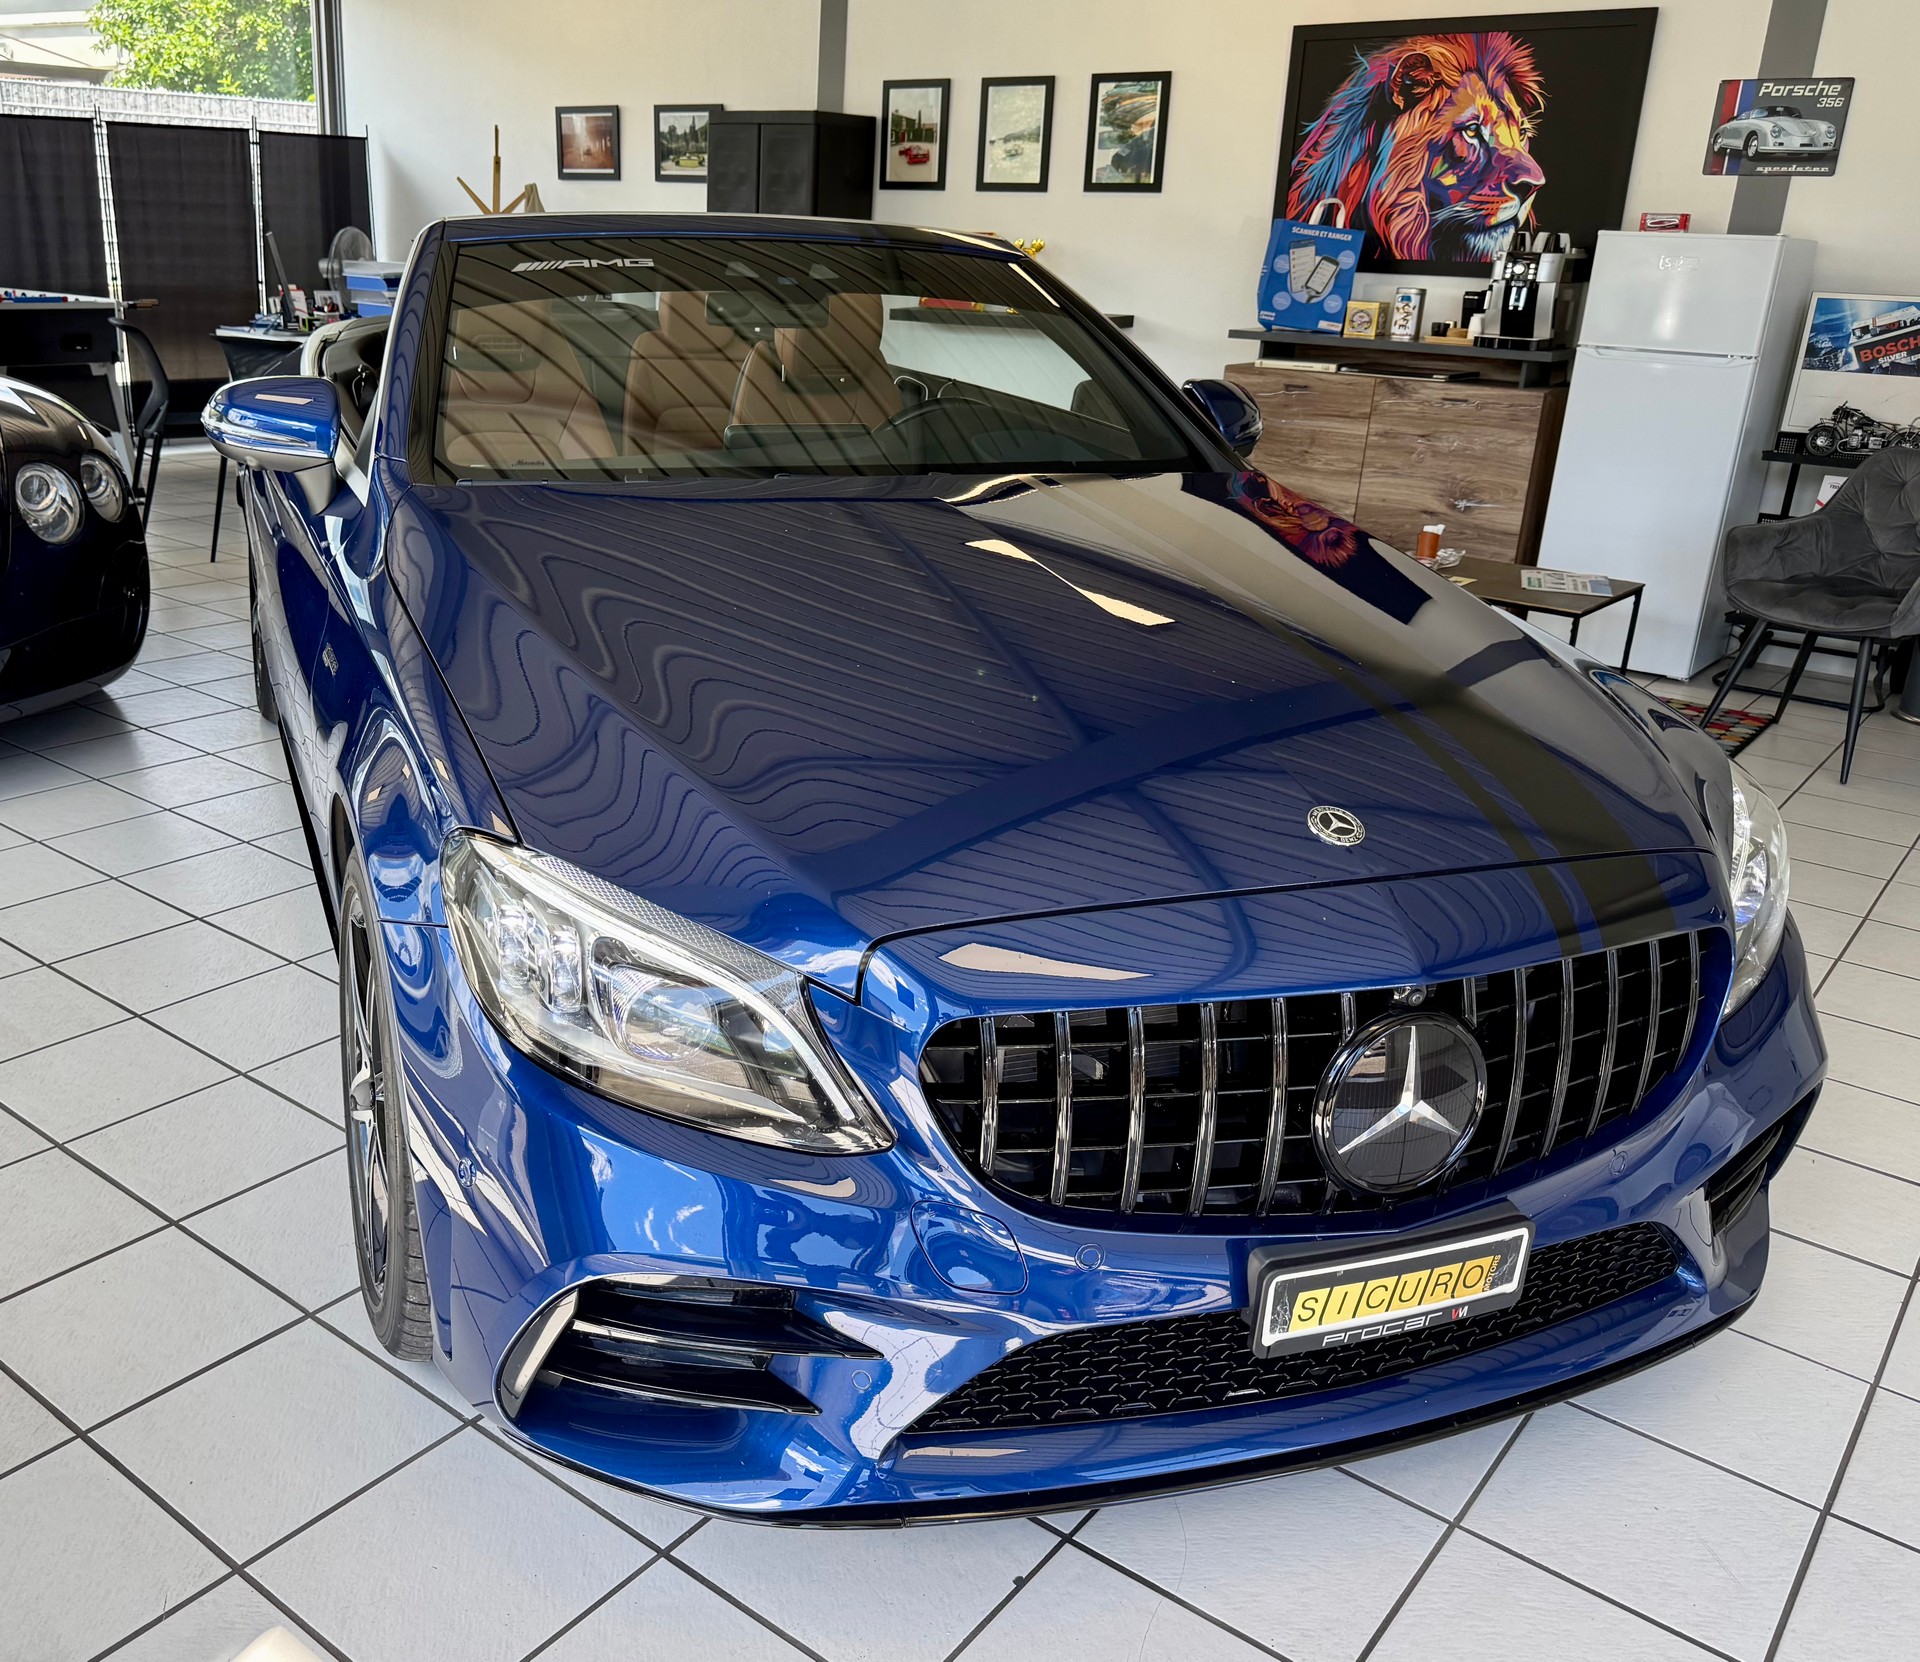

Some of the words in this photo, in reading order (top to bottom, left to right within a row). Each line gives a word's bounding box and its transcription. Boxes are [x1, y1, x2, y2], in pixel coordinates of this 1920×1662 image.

[1759, 80, 1841, 97] Porsche
[1816, 97, 1845, 108] 356
[1755, 164, 1830, 174] speedster
[1292, 226, 1320, 237] SCANNER
[1328, 232, 1352, 241] RANGER
[552, 258, 655, 270] AMG
[1859, 334, 1920, 363] BOSCH
[1878, 351, 1908, 364] SILVER
[1483, 1254, 1502, 1292] MOTORS
[1297, 1264, 1485, 1322] SICURO
